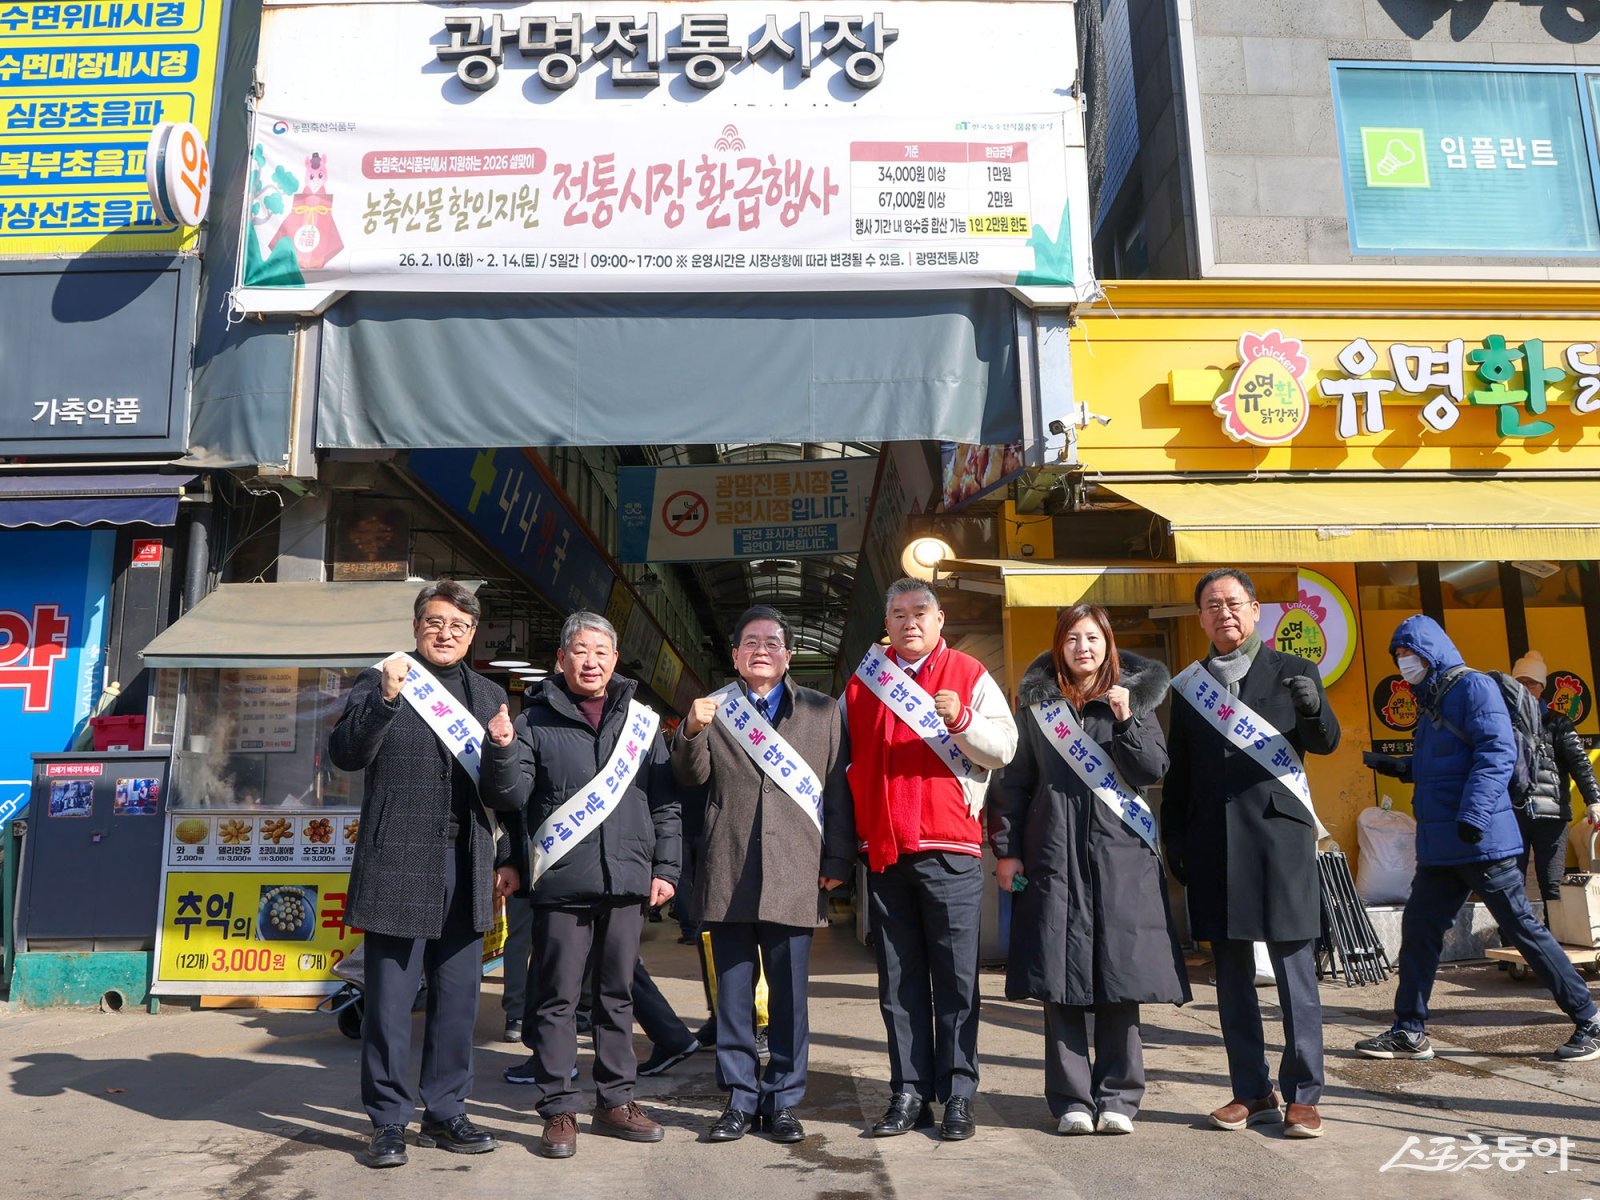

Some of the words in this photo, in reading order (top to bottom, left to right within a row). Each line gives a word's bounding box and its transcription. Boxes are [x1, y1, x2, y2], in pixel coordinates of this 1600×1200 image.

[1, 2, 184, 31] 수면위내시경
[0, 50, 188, 81] 수면대장내시경
[436, 12, 899, 91] 광명전통시장
[6, 100, 164, 130] 심장초음파
[292, 122, 356, 133] 농림축산식품부
[373, 156, 447, 173] 농림축산식품부에서
[448, 155, 482, 171] 지원하는
[483, 155, 508, 170] 2026
[509, 153, 534, 170] 설맞이
[904, 145, 919, 159] 기준
[985, 146, 1013, 160] 환급금액
[1440, 136, 1558, 169] 임플란트
[180, 131, 208, 217] 약
[878, 166, 925, 184] 34,000원
[928, 166, 946, 182] 이상
[987, 167, 1012, 182] 1만원
[552, 153, 692, 229] 전통시장
[695, 154, 839, 231] 환급행사
[878, 191, 925, 210] 67,000원
[928, 191, 946, 209] 이상
[987, 191, 1013, 208] 2만원
[362, 187, 444, 236] 농축산물
[449, 184, 541, 233] 할인지원
[855, 218, 873, 235] 행사
[874, 218, 892, 235] 기간
[893, 218, 902, 233] 내
[904, 218, 929, 234] 영수증
[931, 217, 948, 233] 합산
[949, 217, 967, 233] 가능
[969, 218, 984, 233] 1인
[985, 217, 1009, 233] 2만원
[1010, 217, 1028, 233] 한도
[399, 253, 419, 267] 26.
[421, 253, 433, 267] 2.
[437, 253, 473, 268] 10.(화)
[487, 253, 499, 267] 2.
[503, 253, 539, 268] 14.(토)
[591, 254, 673, 268] 09:00~17:00
[692, 254, 746, 268] 운영시간은
[748, 253, 803, 268] 시장상황에
[805, 254, 827, 268] 따라
[830, 253, 862, 268] 변경될
[865, 254, 876, 267] 수
[879, 253, 904, 267] 있음.
[915, 251, 979, 266] 광명전통시장
[1252, 344, 1297, 373] Chicken
[1239, 373, 1296, 413] 유명환
[31, 397, 141, 425] 가축약품
[1260, 408, 1299, 424] 닭강정
[715, 469, 849, 498] 광명전통시장은
[715, 496, 855, 525] 금연시장입니다.
[0, 603, 70, 712] 약
[877, 670, 894, 687] 복
[890, 682, 922, 712] 많이
[431, 701, 453, 718] 복
[447, 718, 482, 754] 많이
[1195, 681, 1219, 710] 새해
[1217, 703, 1236, 721] 복
[1233, 716, 1272, 750] 많이
[626, 740, 638, 760] 복
[725, 699, 751, 731] 새해
[748, 728, 767, 746] 복
[763, 744, 798, 778] 많이
[1054, 721, 1071, 739] 복
[1068, 738, 1102, 773] 많이
[540, 791, 606, 854] 받으세요
[303, 847, 335, 855] 호도과자
[174, 891, 251, 940] 추억의
[176, 953, 209, 970] (12개)
[211, 949, 286, 972] 3,000원
